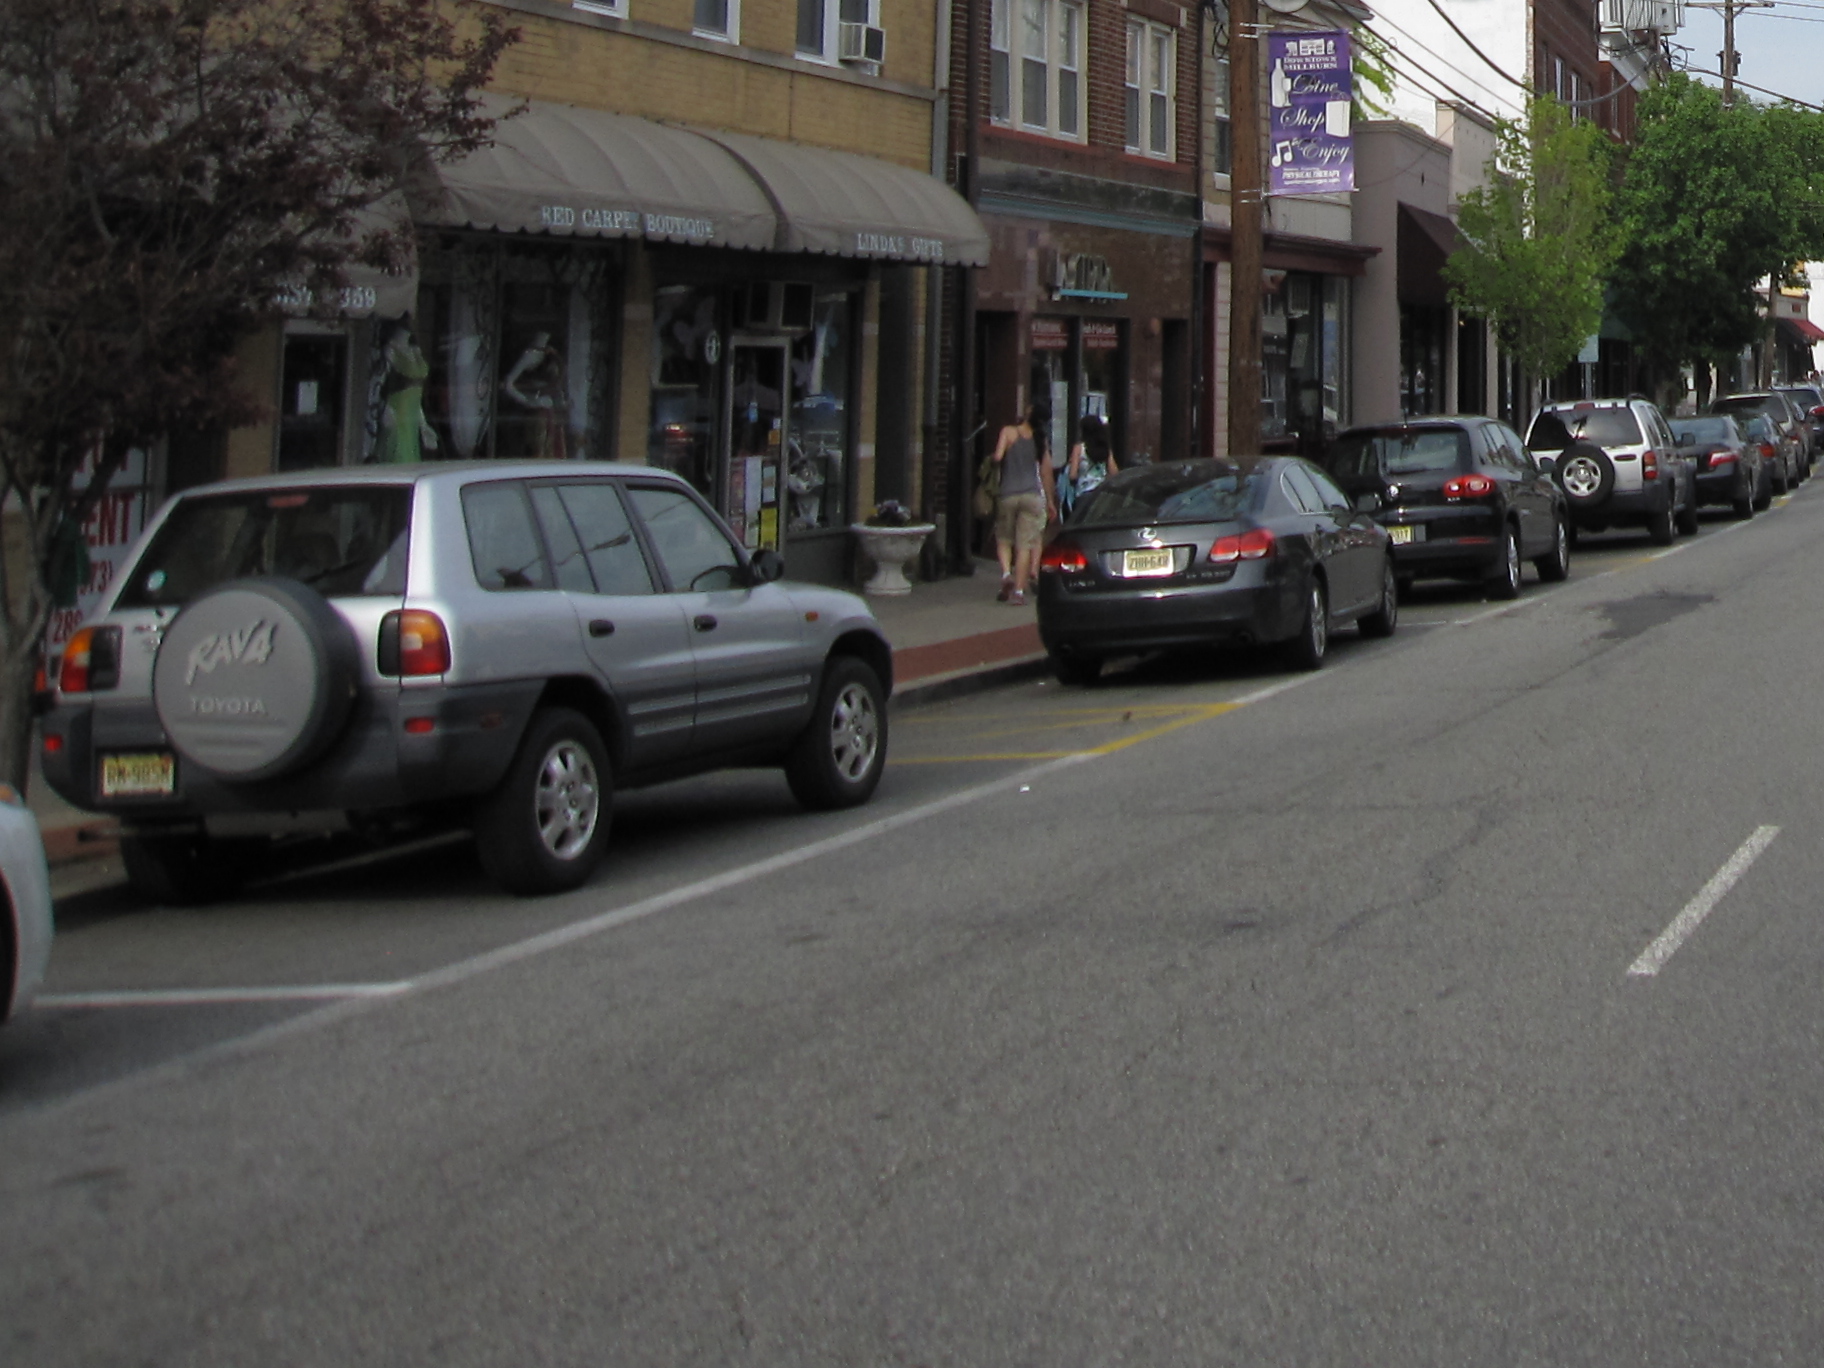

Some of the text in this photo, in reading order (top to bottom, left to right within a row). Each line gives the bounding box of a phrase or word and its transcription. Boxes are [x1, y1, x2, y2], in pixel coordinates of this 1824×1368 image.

[1283, 56, 1337, 64] DOWNTOWN
[1283, 63, 1338, 71] MILLBURN
[1292, 73, 1339, 94] Dine
[1280, 106, 1325, 133] Shop
[1300, 137, 1350, 166] Enjoy
[541, 205, 576, 227] RED
[645, 212, 715, 239] BOUTIQUE
[911, 237, 944, 258] GIFTS
[185, 619, 279, 686] RAV4
[190, 697, 267, 715] TOYOTA
